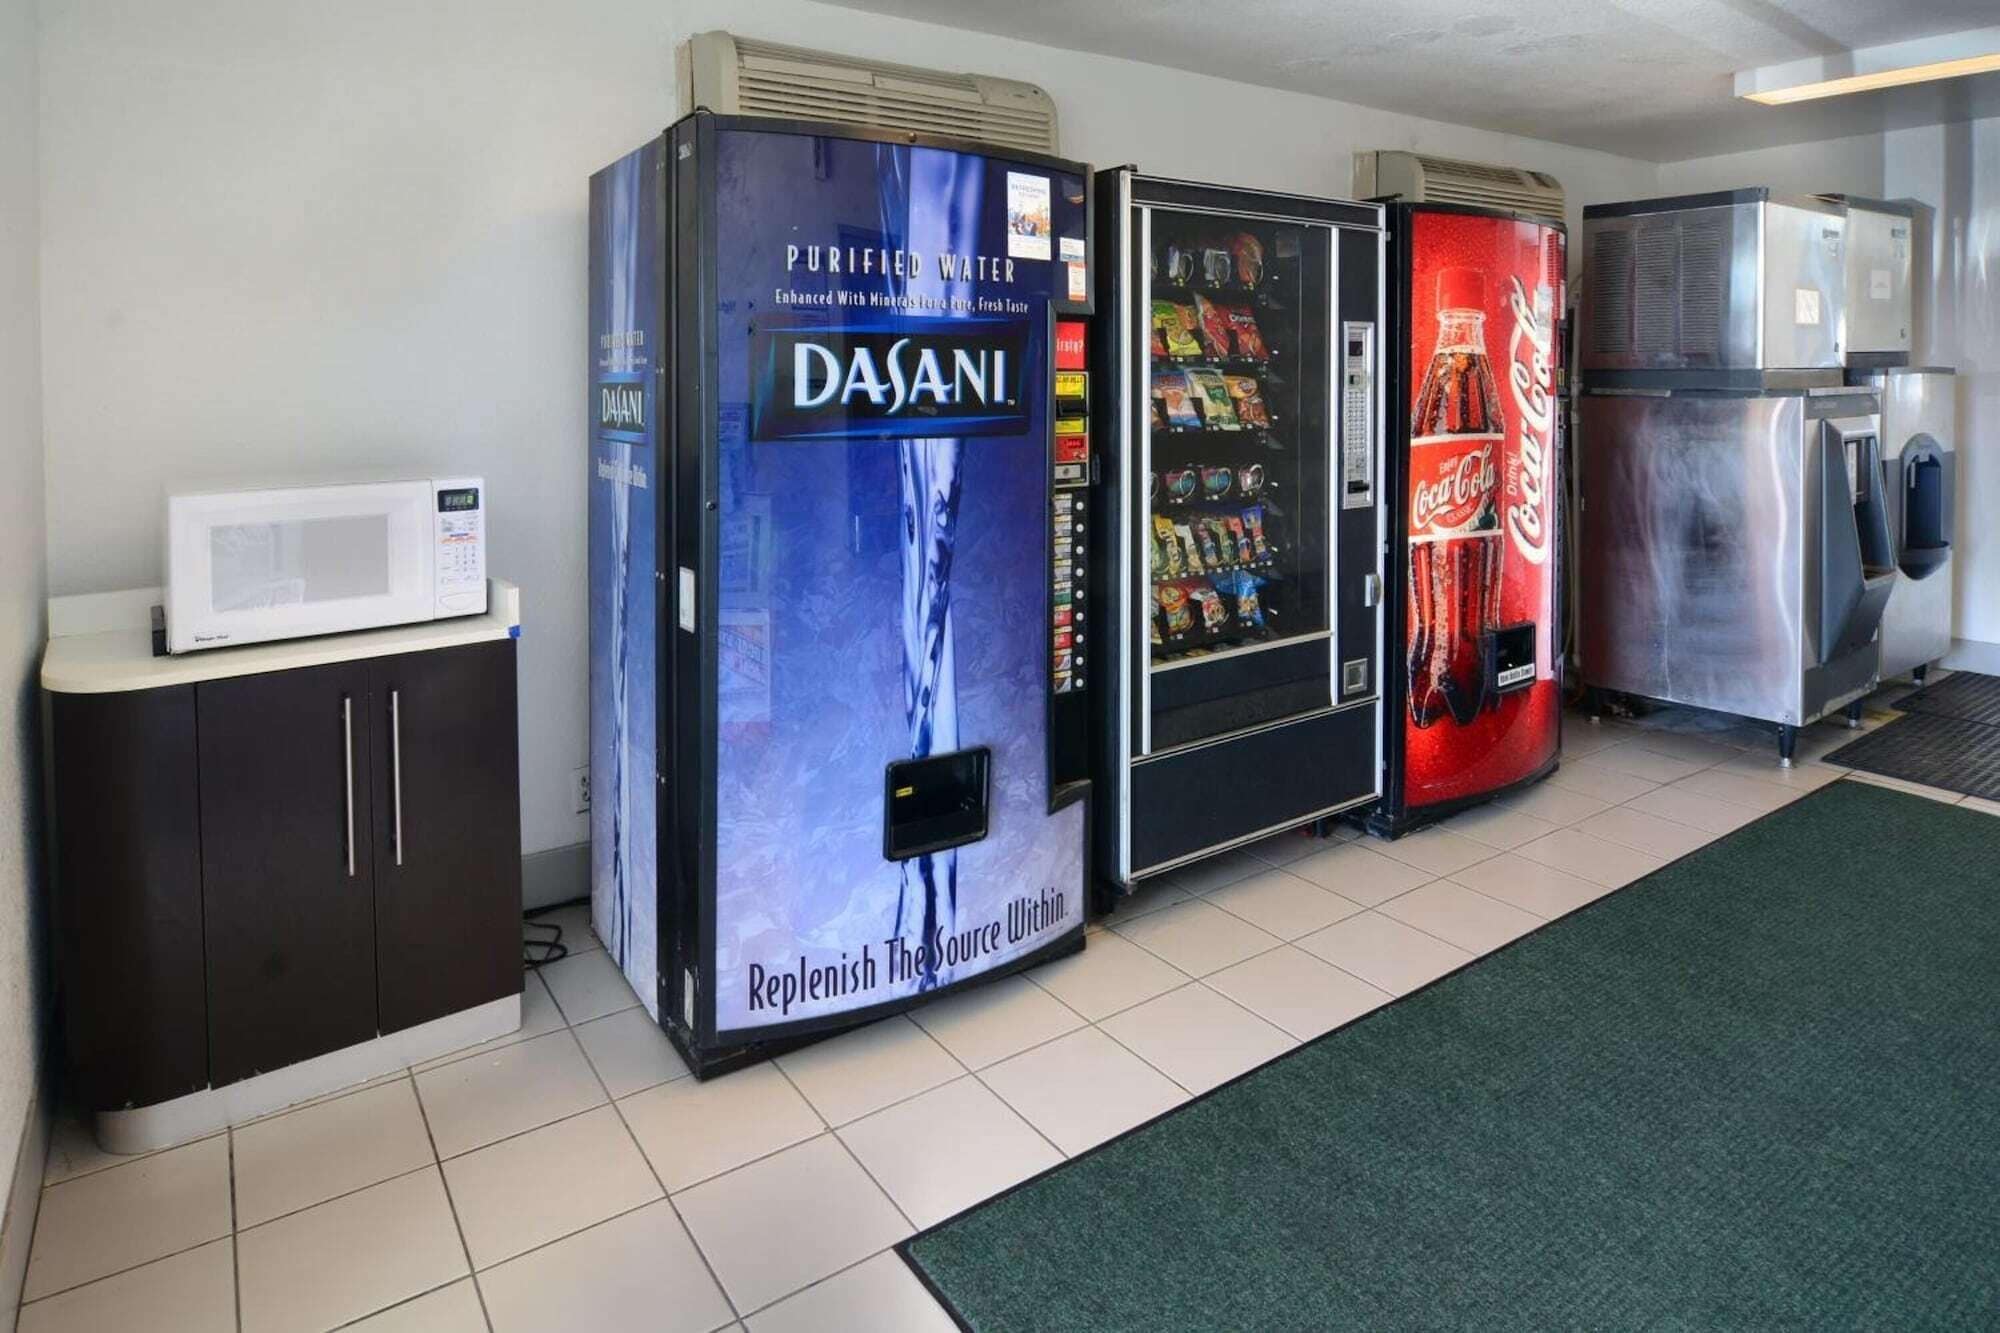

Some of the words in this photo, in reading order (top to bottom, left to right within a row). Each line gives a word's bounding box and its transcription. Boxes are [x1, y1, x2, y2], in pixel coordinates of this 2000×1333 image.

[786, 245, 920, 279] PURIFIED
[939, 255, 1015, 283] WATER
[775, 288, 833, 305] Enhanced
[837, 289, 866, 306] With
[979, 296, 1004, 313] Fresh
[1006, 298, 1029, 314] Taste
[602, 384, 643, 428] DASANI
[793, 337, 1008, 415] DASANI
[1413, 440, 1495, 529] Coca-Cola
[749, 944, 876, 1016] Replenish
[885, 937, 926, 984] The
[935, 921, 1001, 972] Source
